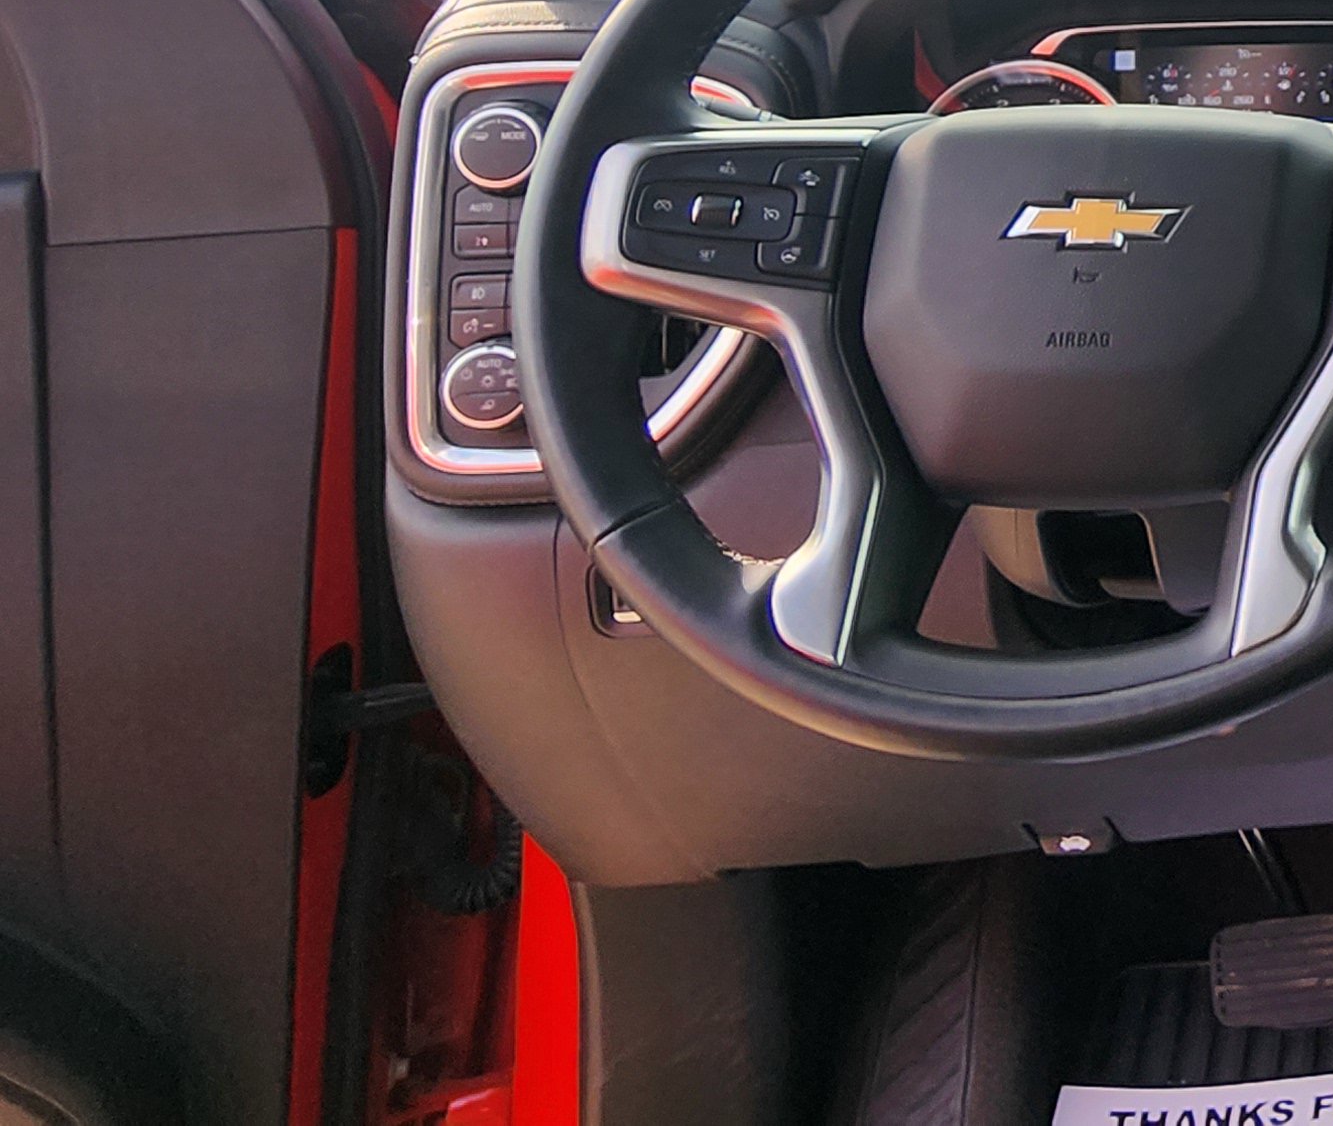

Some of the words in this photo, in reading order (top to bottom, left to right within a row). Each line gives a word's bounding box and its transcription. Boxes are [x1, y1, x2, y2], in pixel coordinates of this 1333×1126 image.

[501, 131, 527, 141] MODE
[469, 203, 493, 212] AUTO
[699, 250, 716, 259] SET
[1045, 331, 1111, 348] AIRBAG
[477, 359, 502, 369] AUTO
[1110, 1100, 1294, 1126] THANKS
